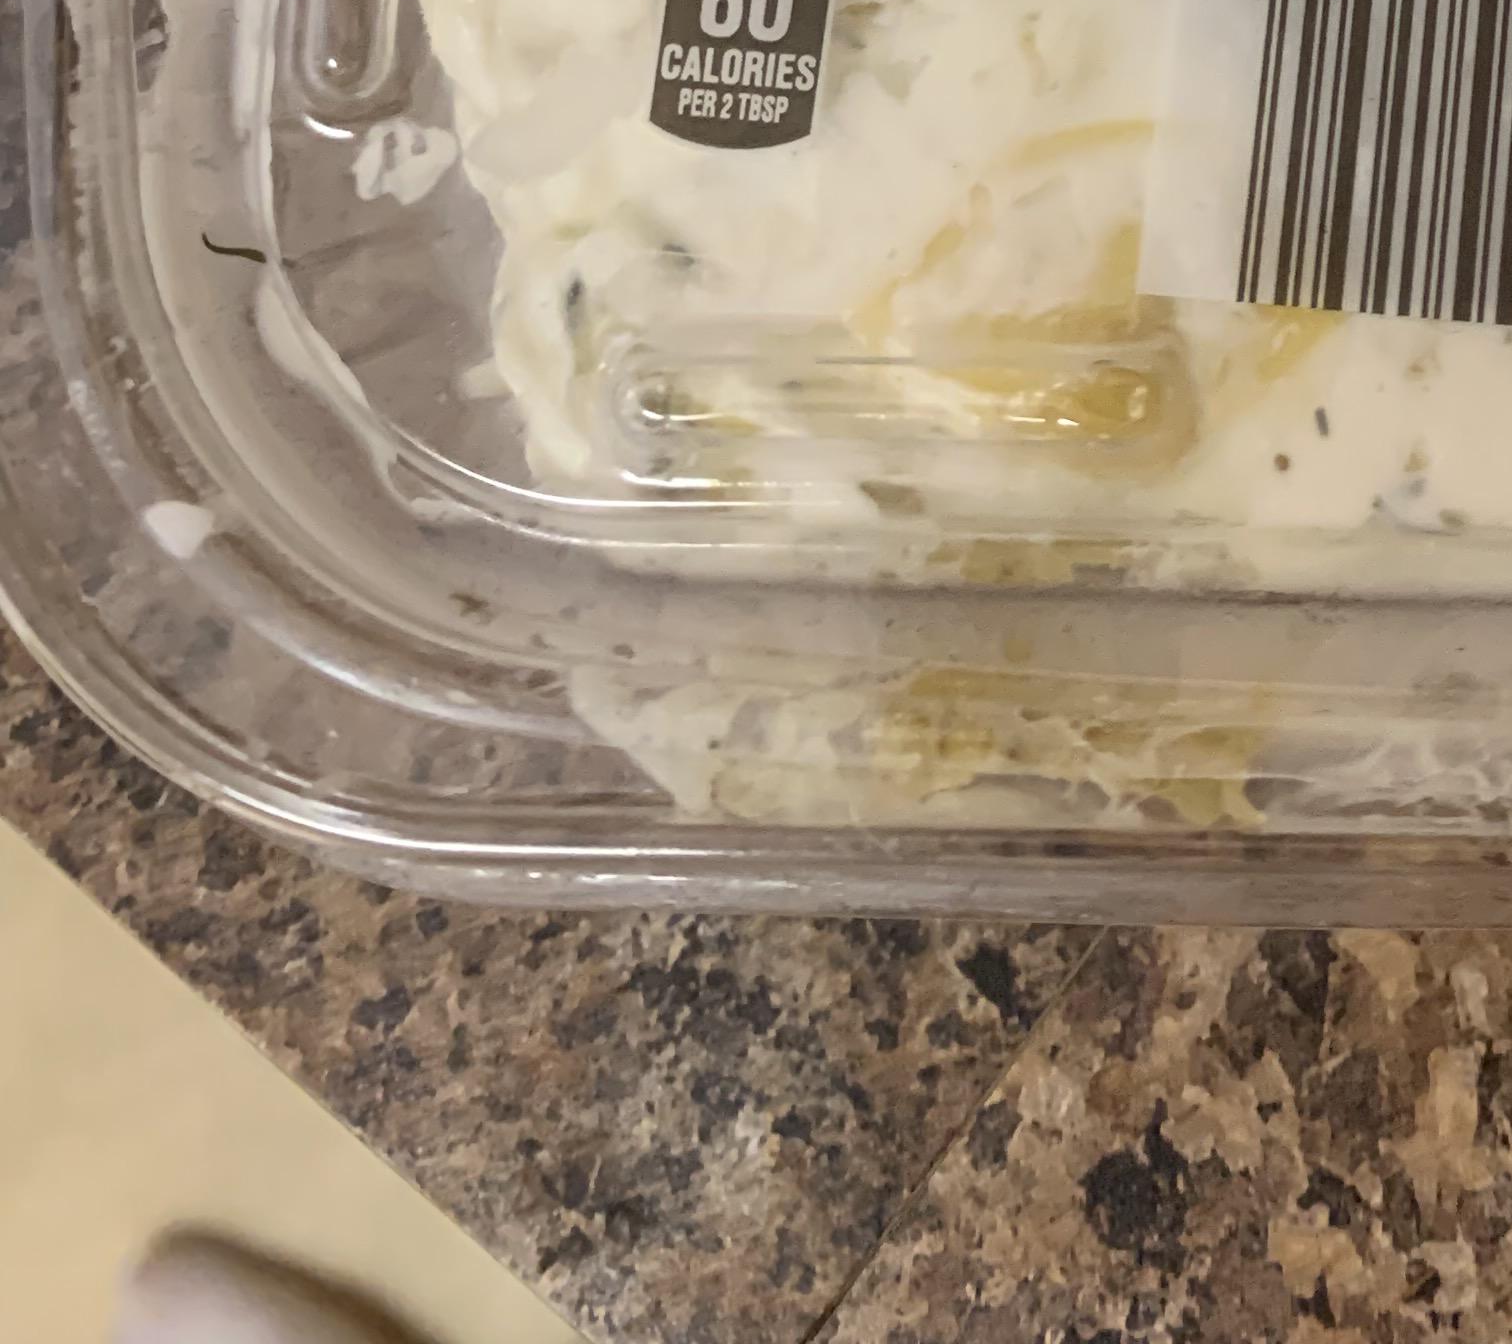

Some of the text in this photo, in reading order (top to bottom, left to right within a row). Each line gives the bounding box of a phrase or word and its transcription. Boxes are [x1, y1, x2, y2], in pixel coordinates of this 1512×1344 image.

[660, 43, 816, 93] CALORIES
[677, 88, 790, 125] PER 2 TBSP
